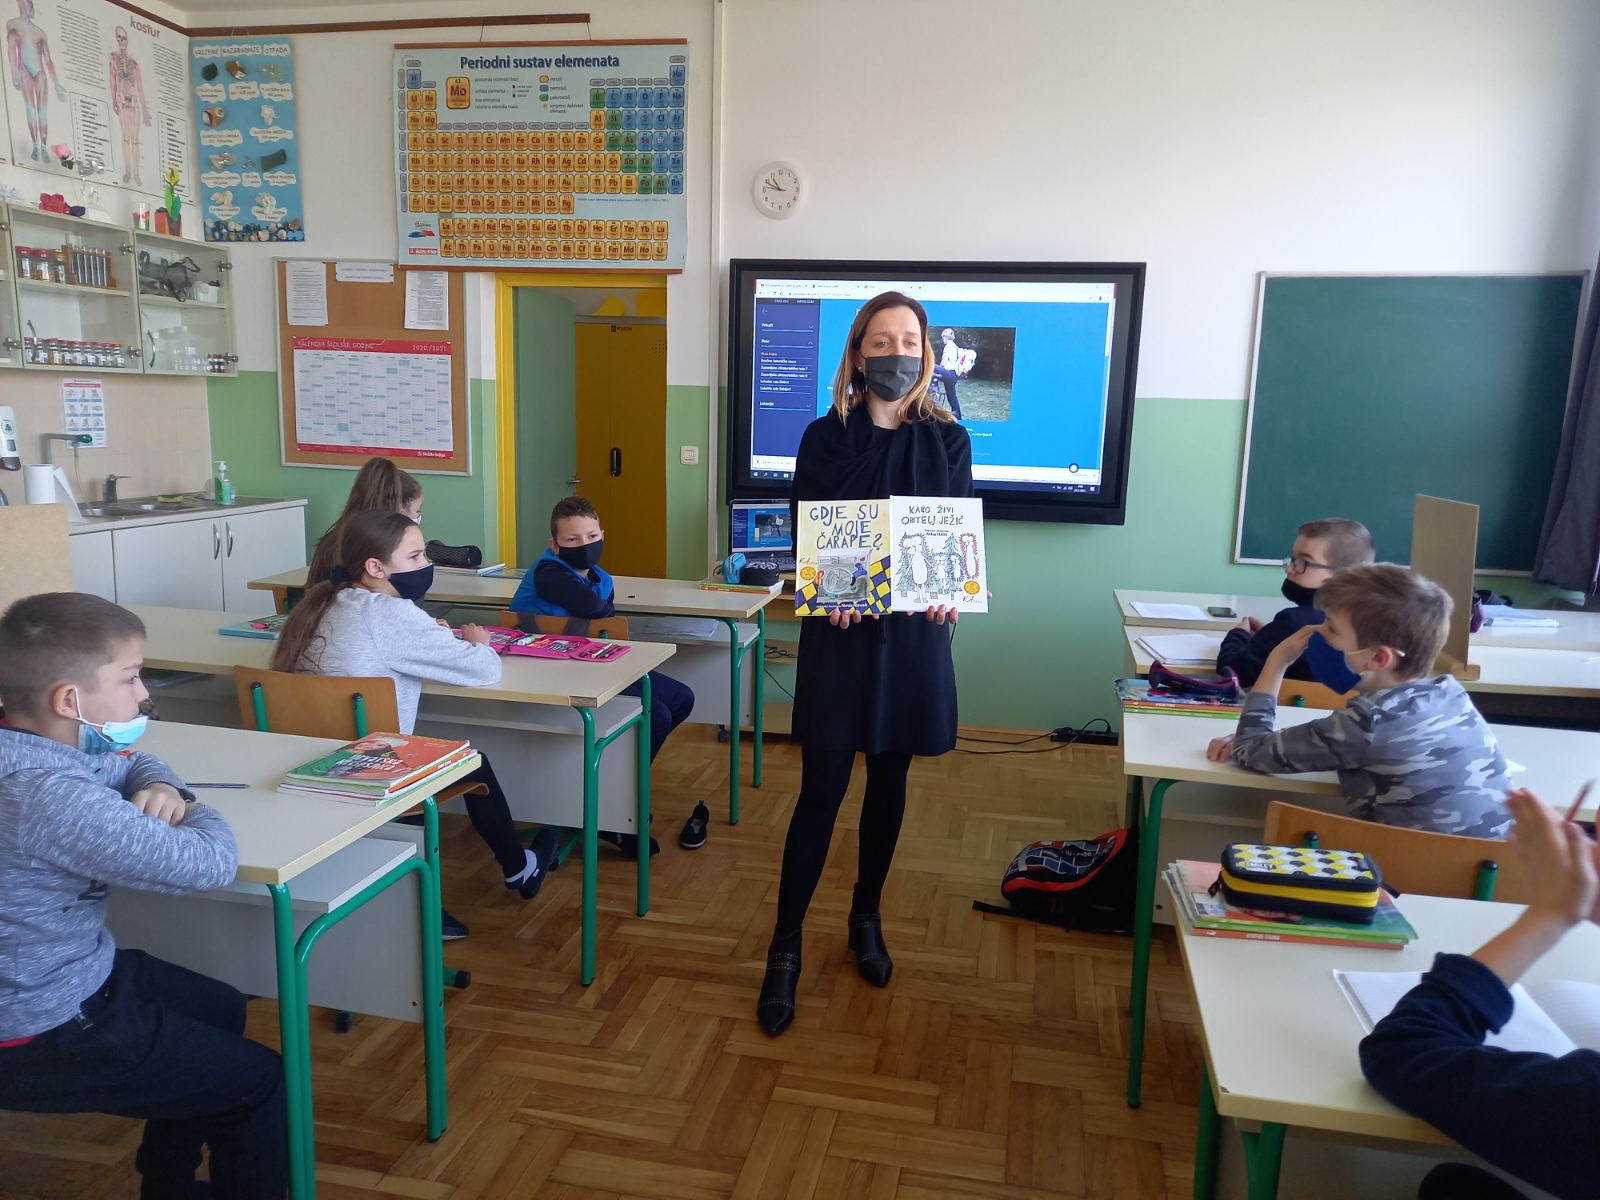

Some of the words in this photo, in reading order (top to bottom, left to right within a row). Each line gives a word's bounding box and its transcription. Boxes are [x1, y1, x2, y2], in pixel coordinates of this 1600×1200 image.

[130, 16, 160, 38] kostur
[264, 46, 288, 54] OTPADA
[460, 55, 510, 69] Periodni
[513, 57, 551, 69] sustav
[554, 54, 620, 68] elemenata
[450, 86, 466, 96] Mo
[810, 506, 847, 526] GDJE
[857, 504, 878, 520] SU
[909, 505, 930, 514] KAKO
[936, 504, 954, 514] ŽIVI
[939, 514, 964, 525] JEŽIĆ
[832, 520, 871, 539] MOJE
[816, 532, 883, 550] ČARAPE?
